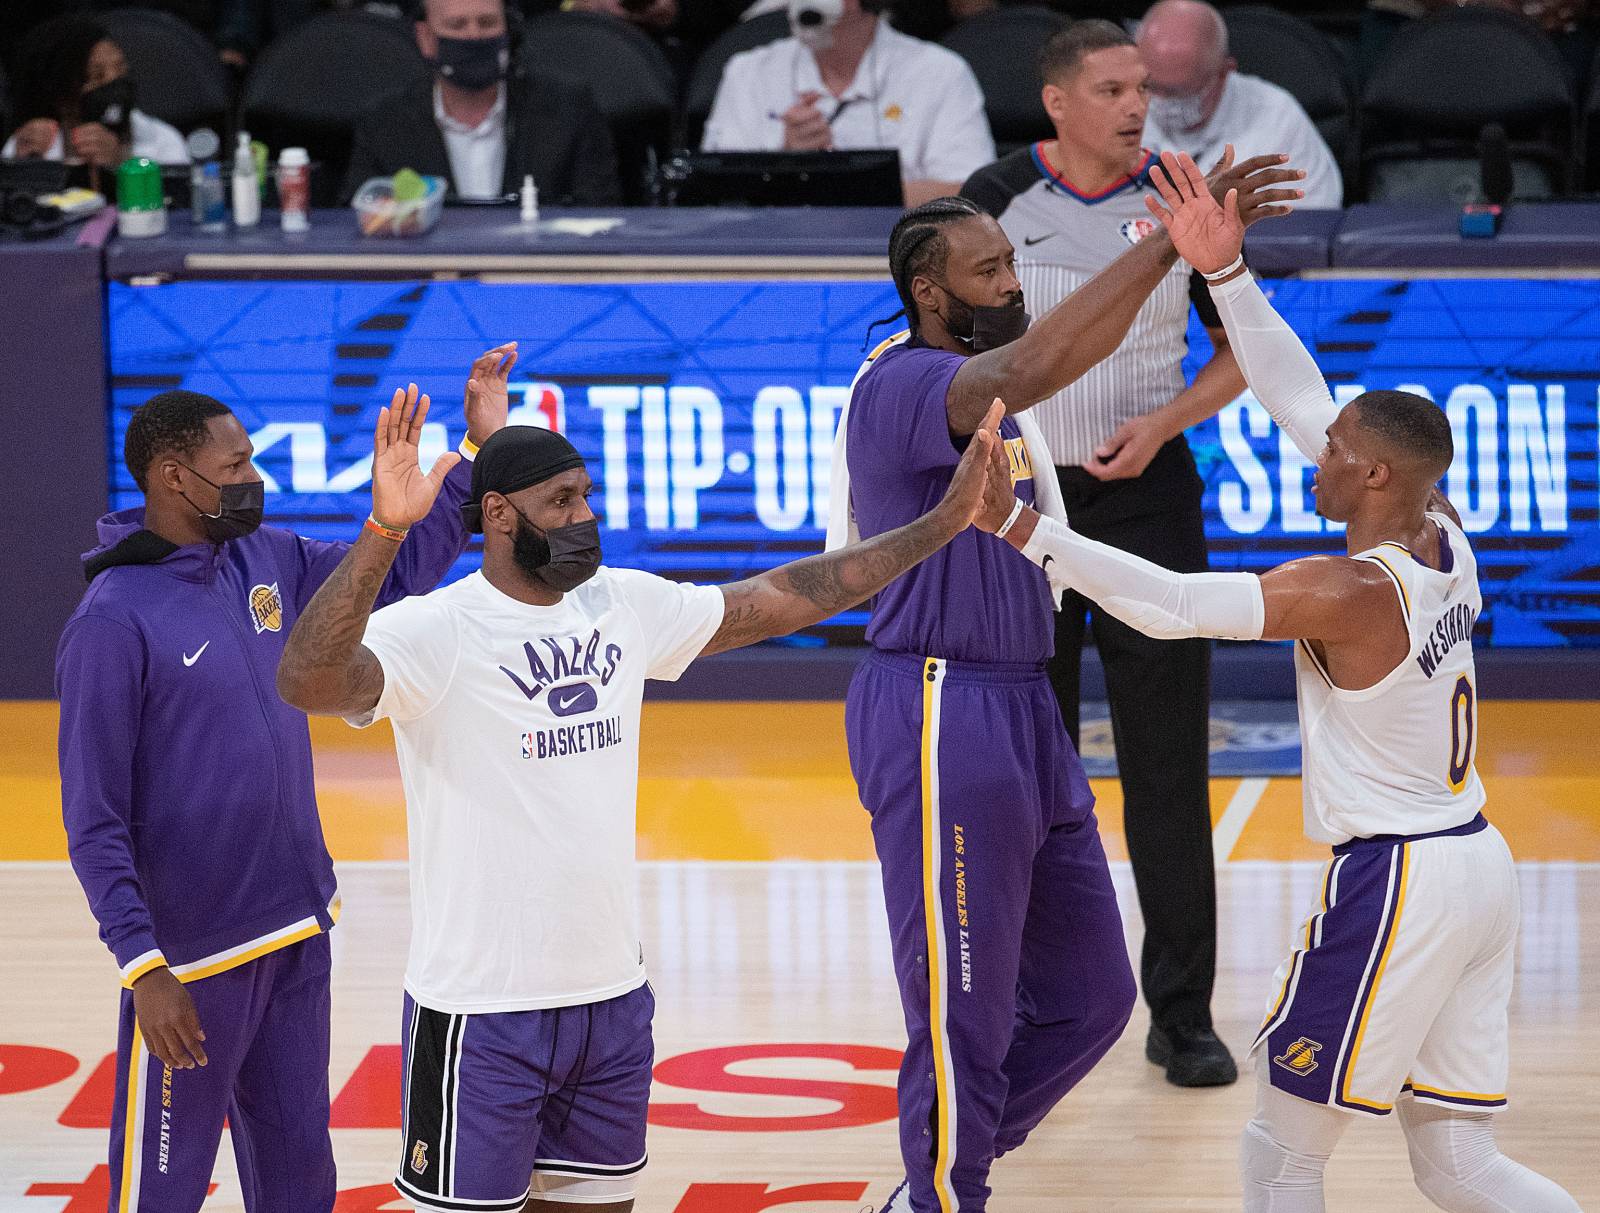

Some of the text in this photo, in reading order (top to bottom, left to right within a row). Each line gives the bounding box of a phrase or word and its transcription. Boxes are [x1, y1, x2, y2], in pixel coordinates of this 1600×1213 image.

[499, 628, 622, 701] LAKERS
[536, 715, 622, 759] BASKETBALL
[1447, 672, 1473, 796] 0
[954, 824, 972, 993] LOS ANGELES LAKERS
[159, 1108, 171, 1175] LAKERS
